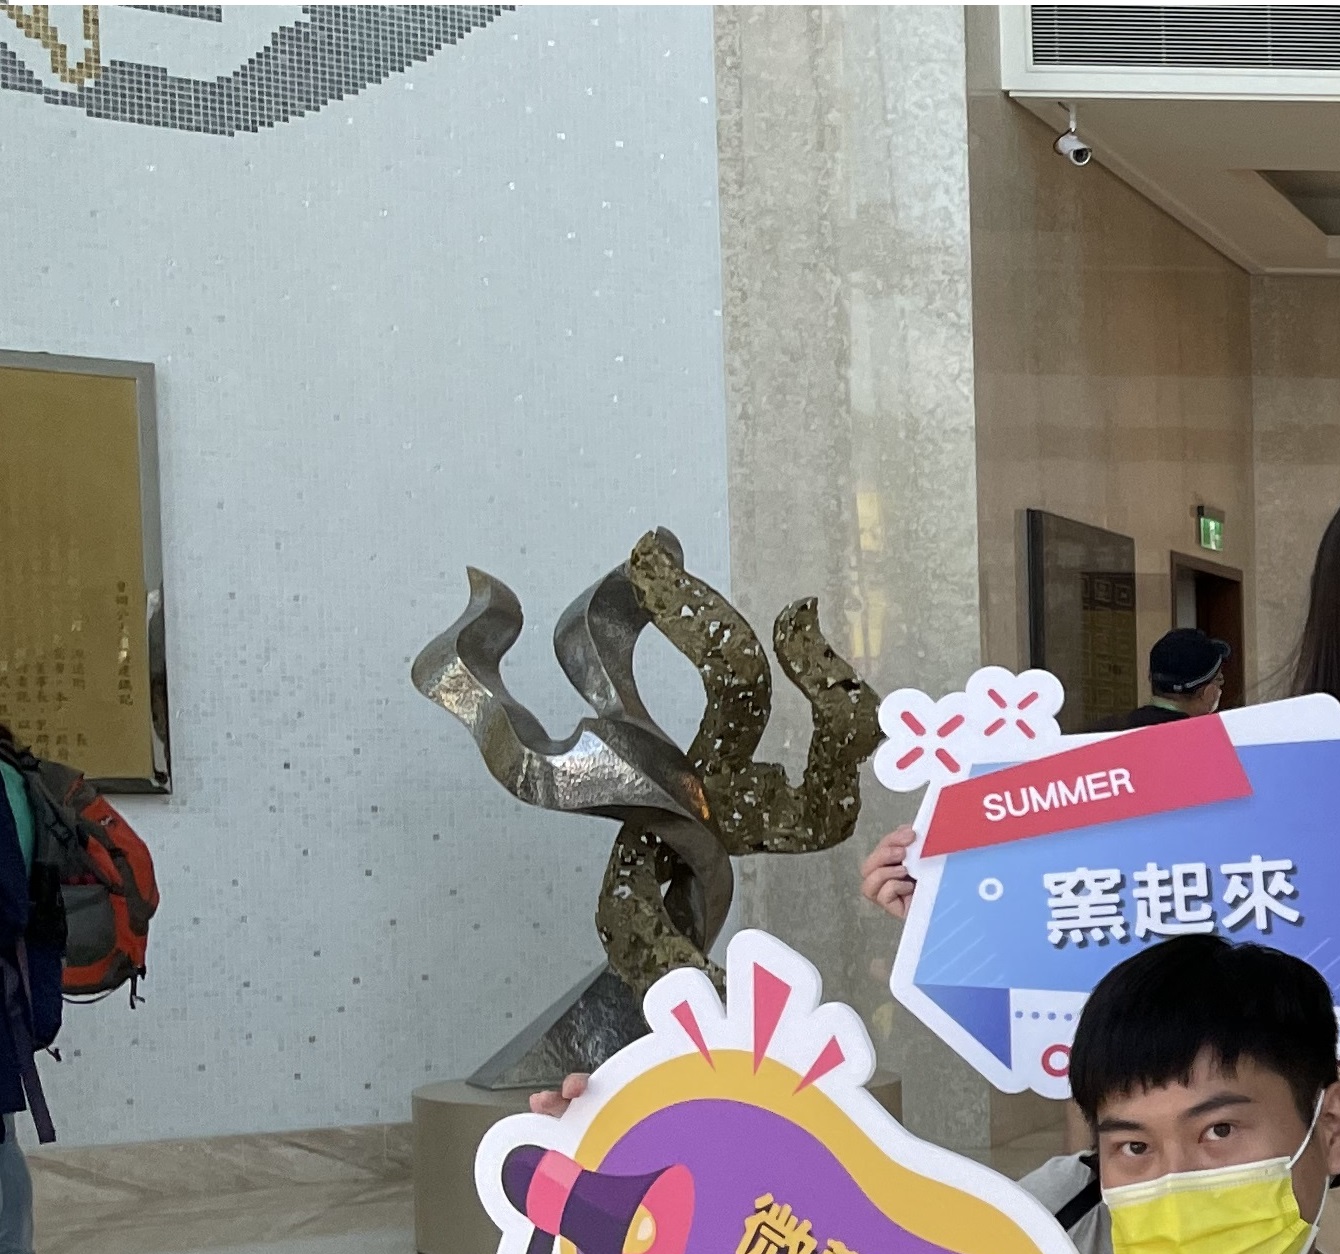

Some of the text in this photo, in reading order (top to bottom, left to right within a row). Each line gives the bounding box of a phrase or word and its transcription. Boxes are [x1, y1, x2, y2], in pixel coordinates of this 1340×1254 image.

[983, 767, 1135, 822] SUMMER
[1043, 855, 1301, 945] 窯起來
